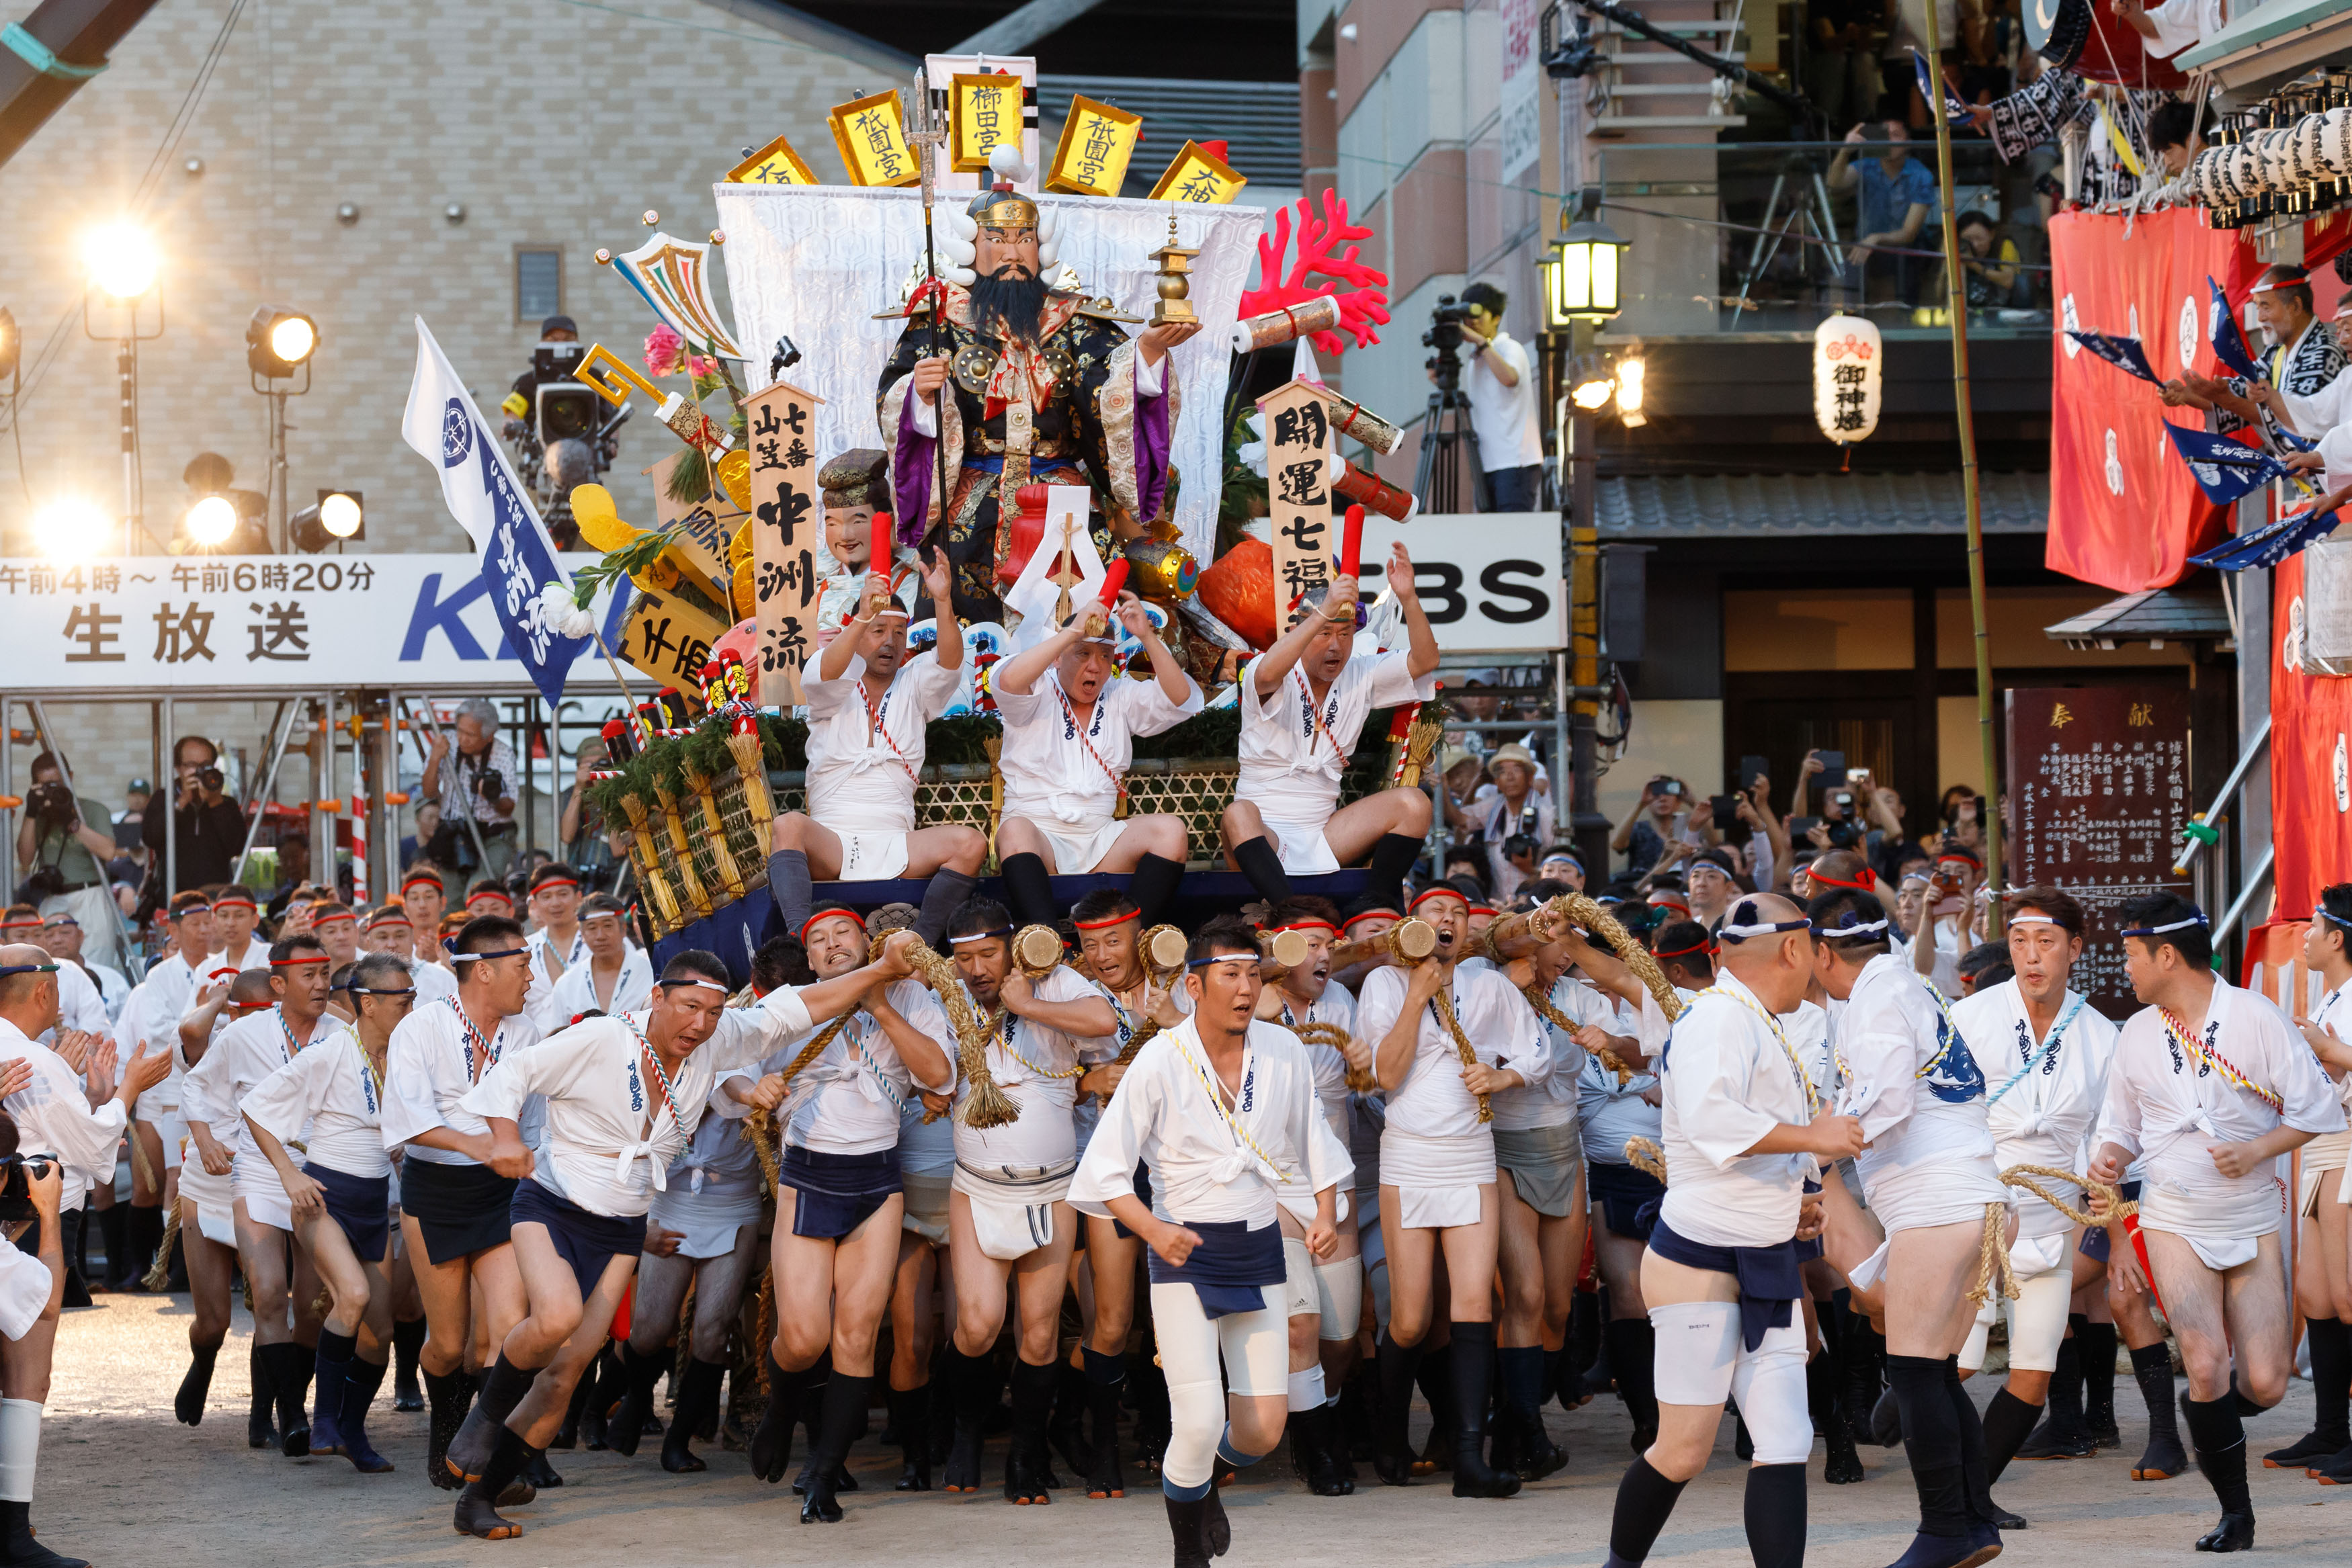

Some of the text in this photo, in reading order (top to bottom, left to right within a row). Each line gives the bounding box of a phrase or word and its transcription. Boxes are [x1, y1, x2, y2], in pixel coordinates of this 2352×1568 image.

[757, 481, 816, 673] 中洲流
[1274, 400, 1329, 633] 開運七福
[62, 601, 312, 663] 生放送
[2168, 740, 2185, 875] 博多祇園山笠振興
